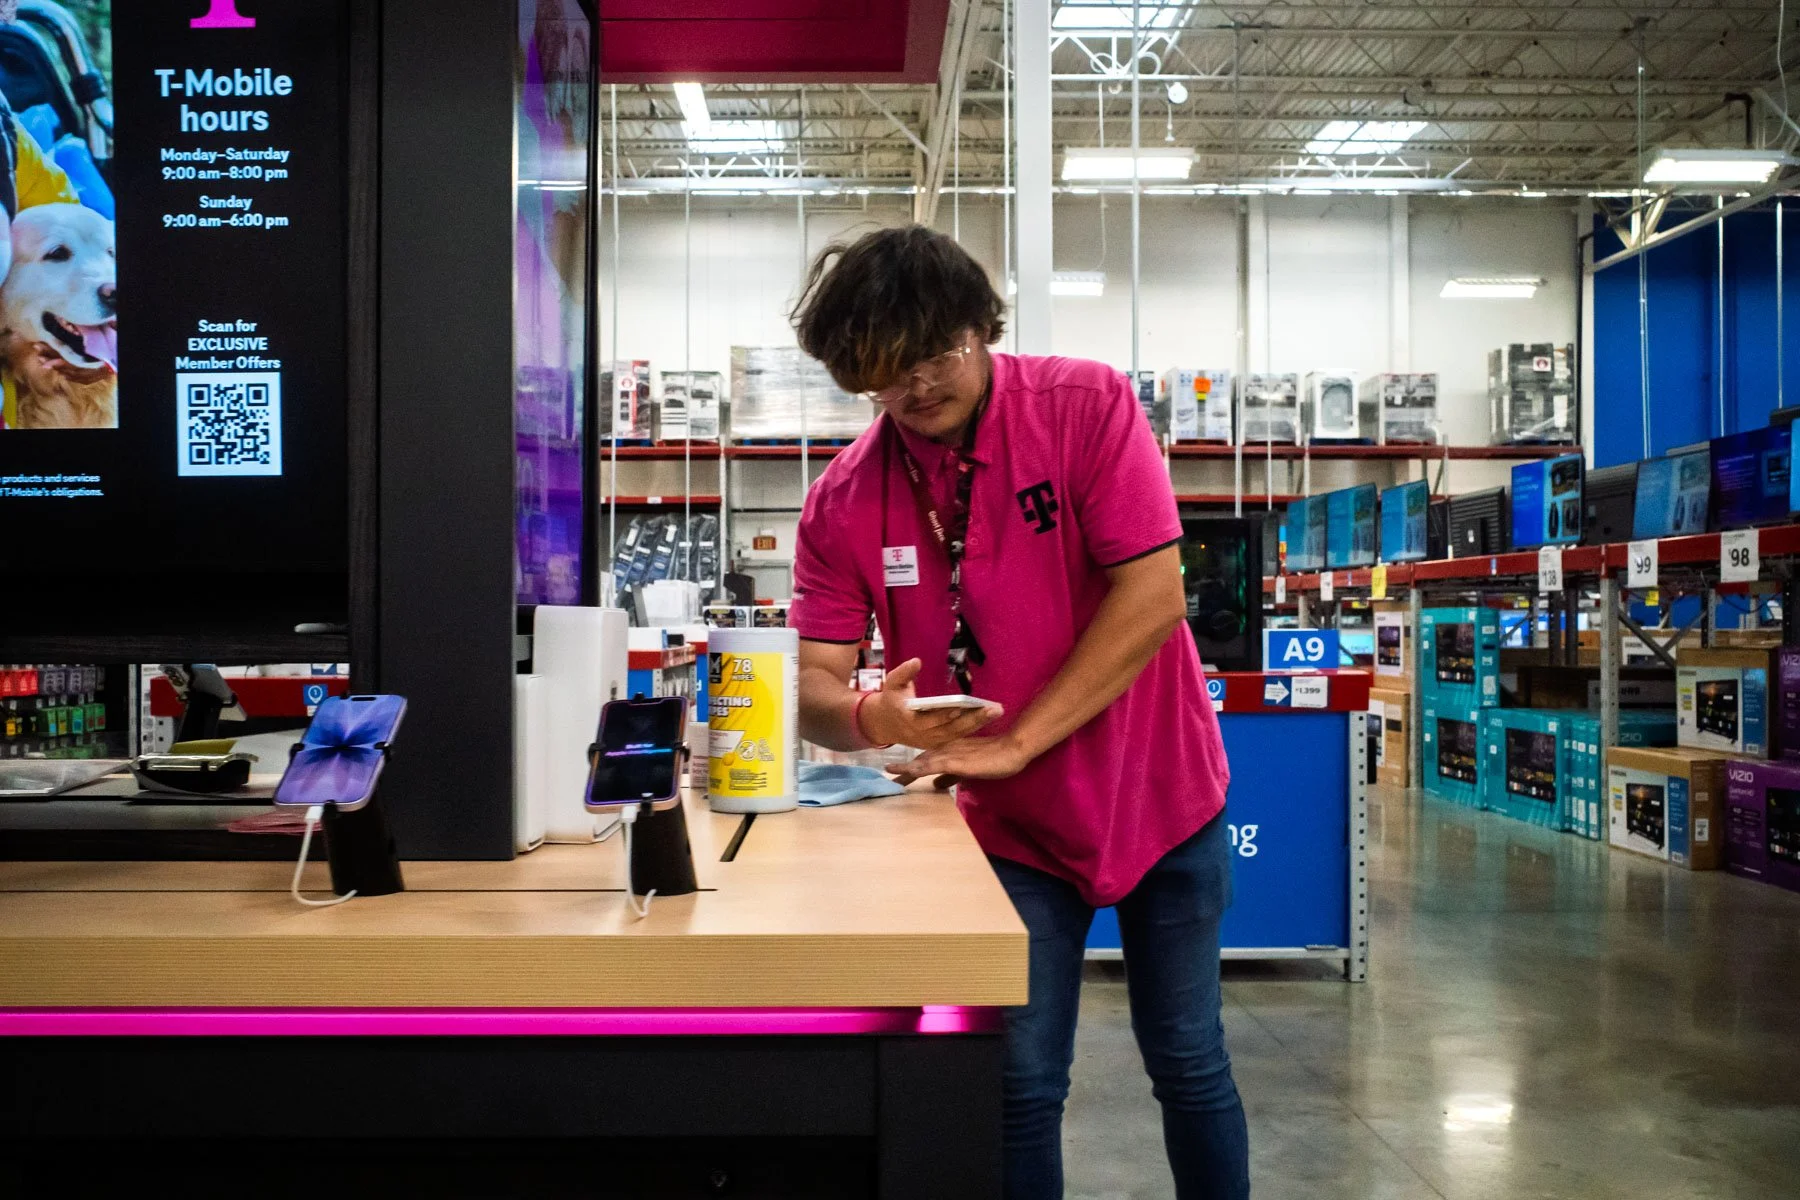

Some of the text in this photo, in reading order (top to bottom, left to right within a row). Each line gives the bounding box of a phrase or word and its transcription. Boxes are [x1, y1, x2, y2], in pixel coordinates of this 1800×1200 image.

[155, 68, 293, 98] T-Mobile
[181, 104, 269, 133] hours
[162, 166, 196, 181] 9:00
[265, 169, 289, 183] pm
[199, 195, 253, 211] Sunday
[163, 213, 197, 229] 9:00
[265, 217, 290, 230] pm
[198, 319, 258, 334] Scan for
[188, 337, 268, 352] EXCLUSIVE
[176, 356, 282, 371] Member Offers
[2, 473, 43, 485] products
[44, 473, 62, 483] and
[62, 474, 101, 483] services
[5, 487, 50, 497] T-Mobile's
[1016, 480, 1058, 534] T
[1283, 637, 1325, 662] A9
[733, 658, 752, 674] 78
[1728, 768, 1754, 783] VIZIO
